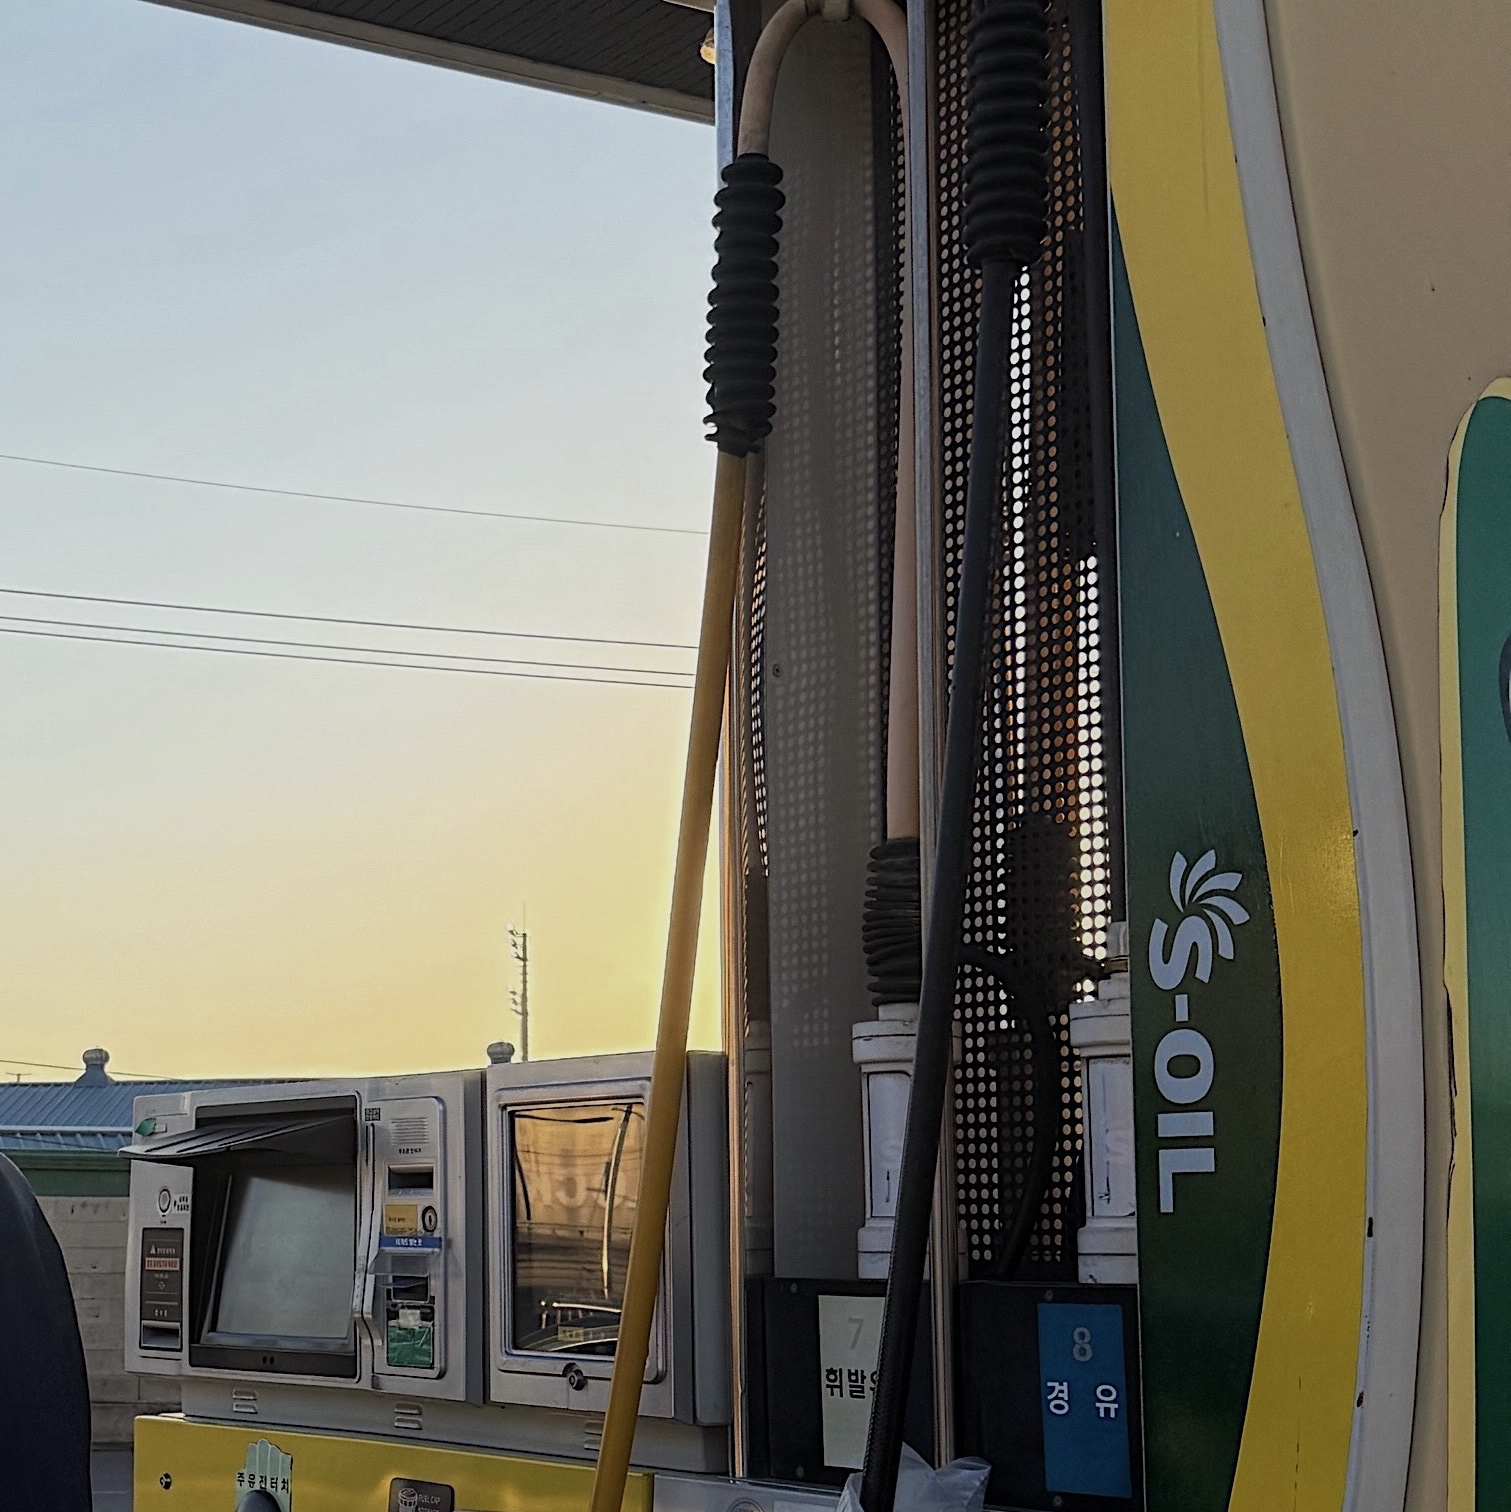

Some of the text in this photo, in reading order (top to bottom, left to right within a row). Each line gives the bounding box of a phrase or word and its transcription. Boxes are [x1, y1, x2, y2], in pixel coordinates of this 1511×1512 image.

[1147, 914, 1217, 1215] S-OIL
[847, 1317, 864, 1350] 7
[1072, 1327, 1093, 1362] 8
